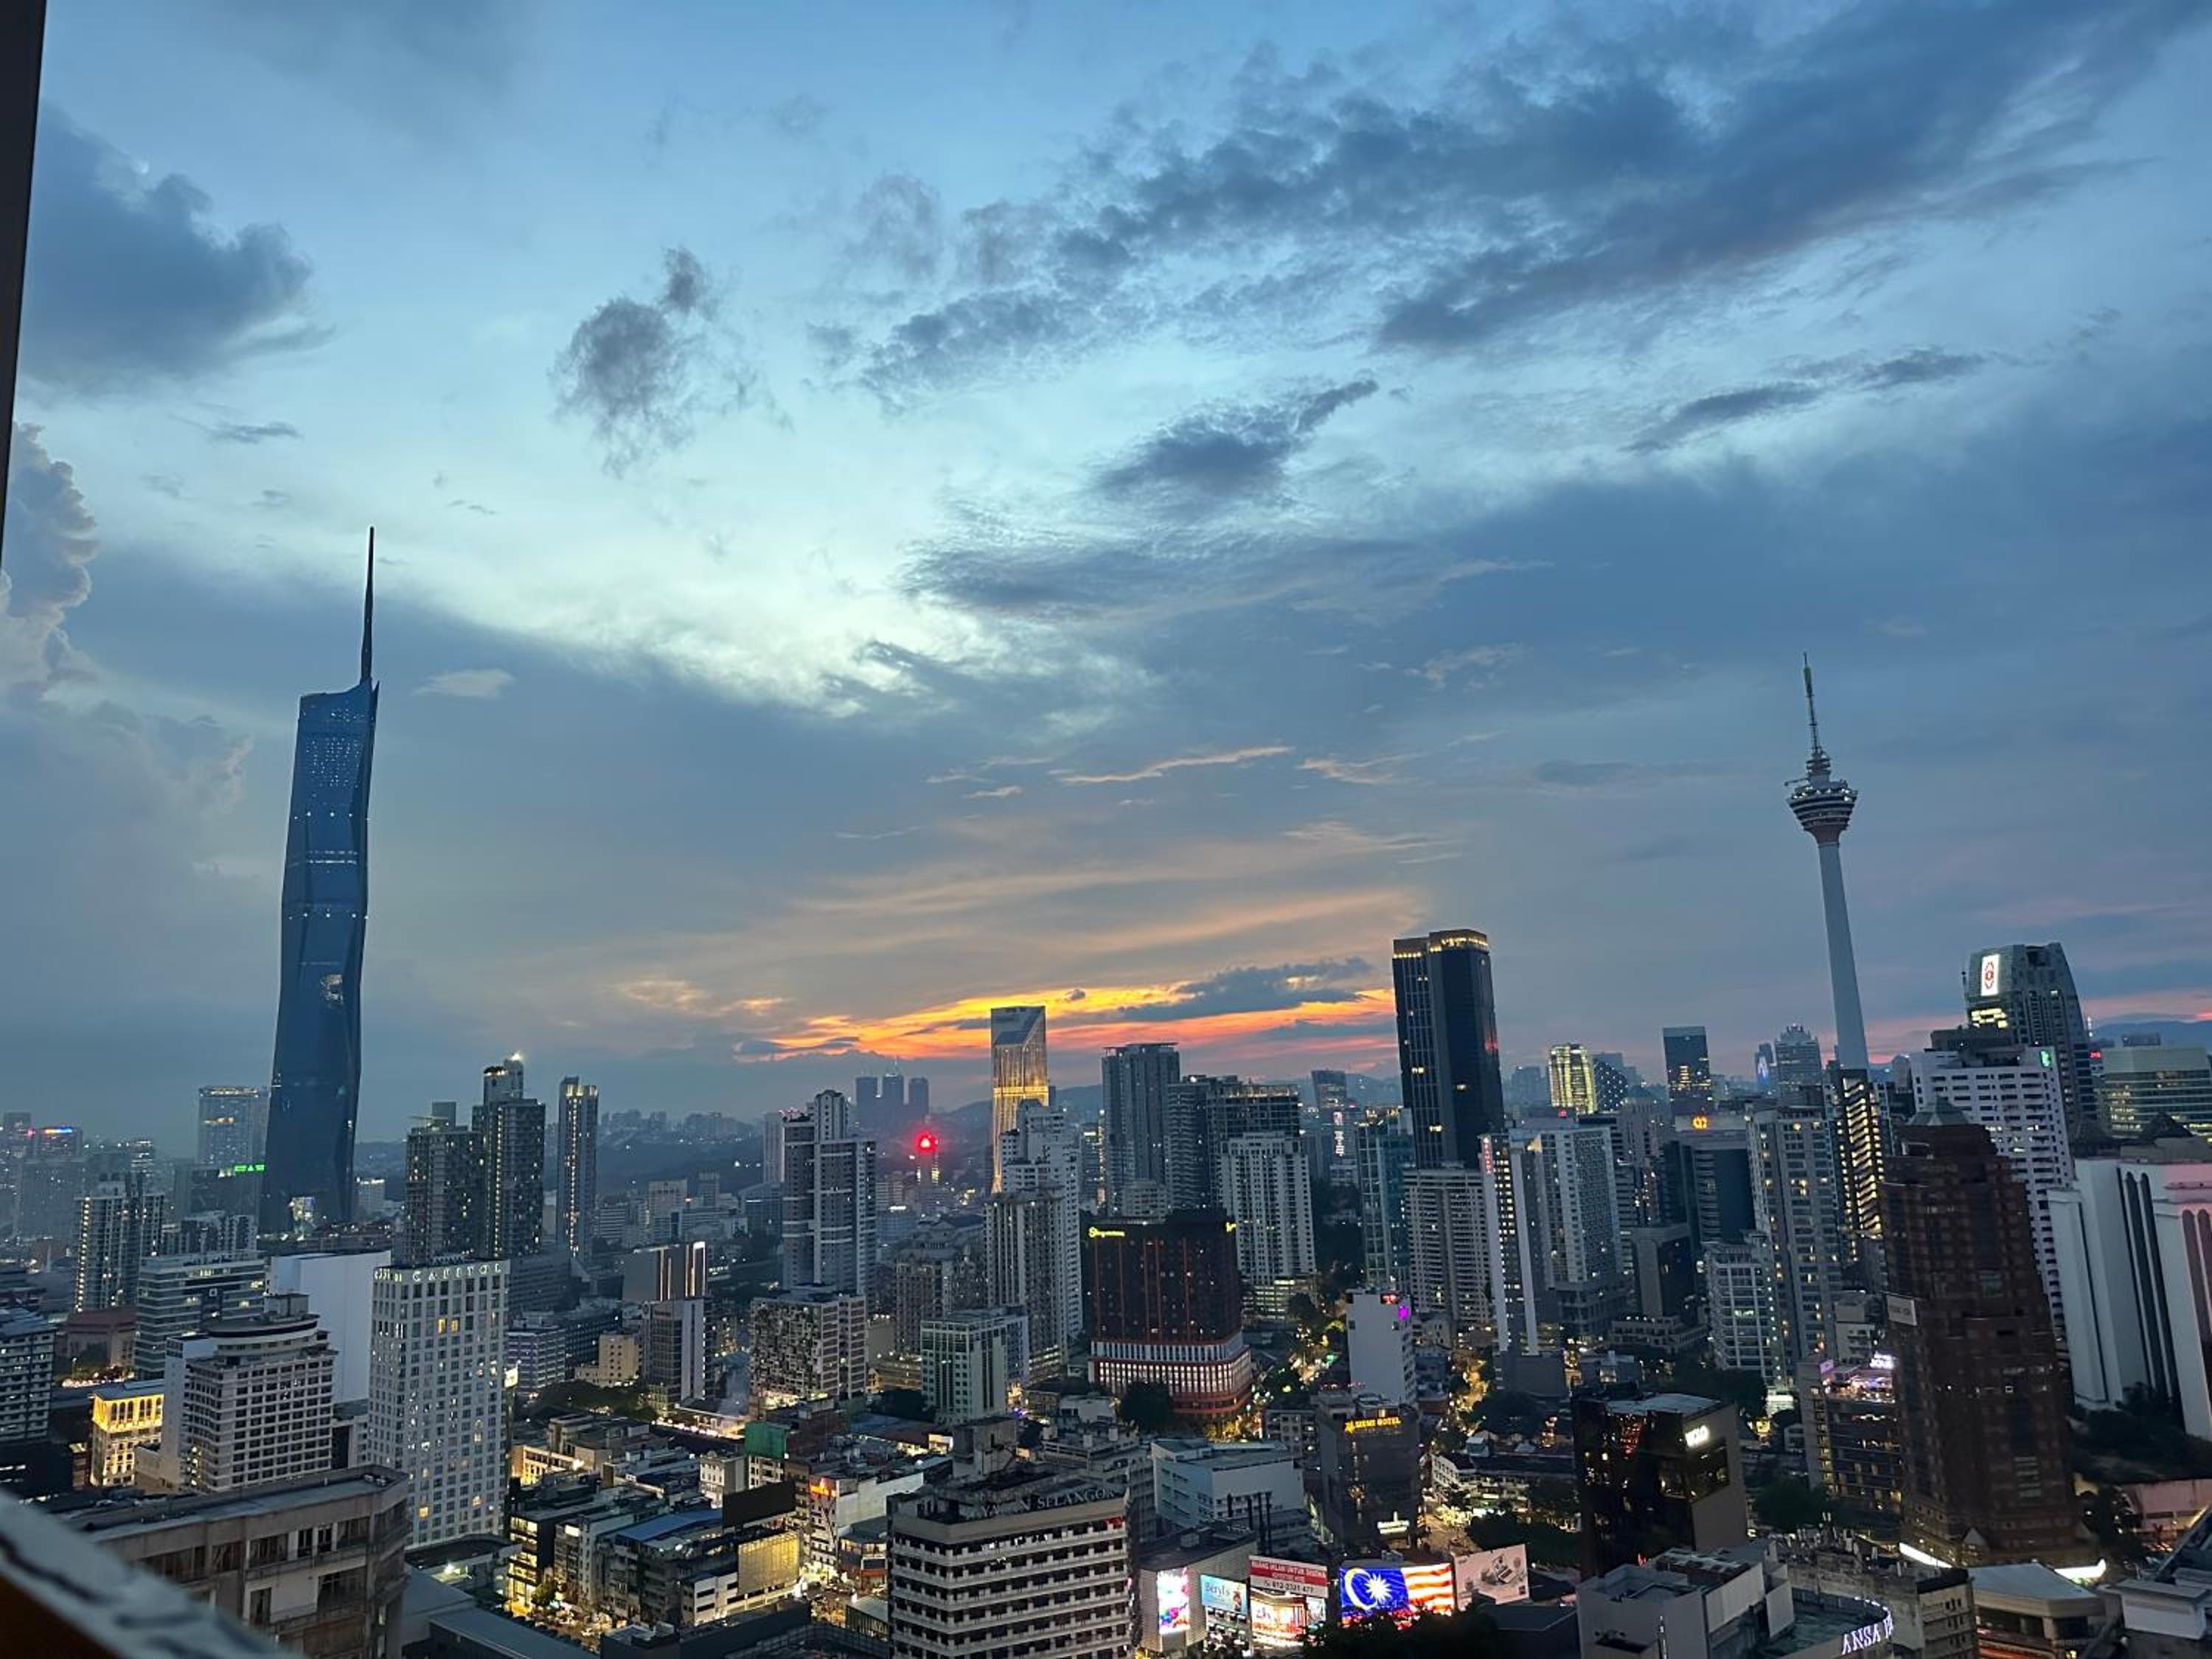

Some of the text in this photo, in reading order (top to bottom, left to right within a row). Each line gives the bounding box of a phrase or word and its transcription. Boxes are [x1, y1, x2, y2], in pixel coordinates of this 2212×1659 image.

[412, 1263, 502, 1283] CAPITOL
[1377, 1416, 1401, 1426] HOTEL
[1037, 1487, 1115, 1509] SELANGOR
[1841, 1623, 1881, 1655] ANSA
